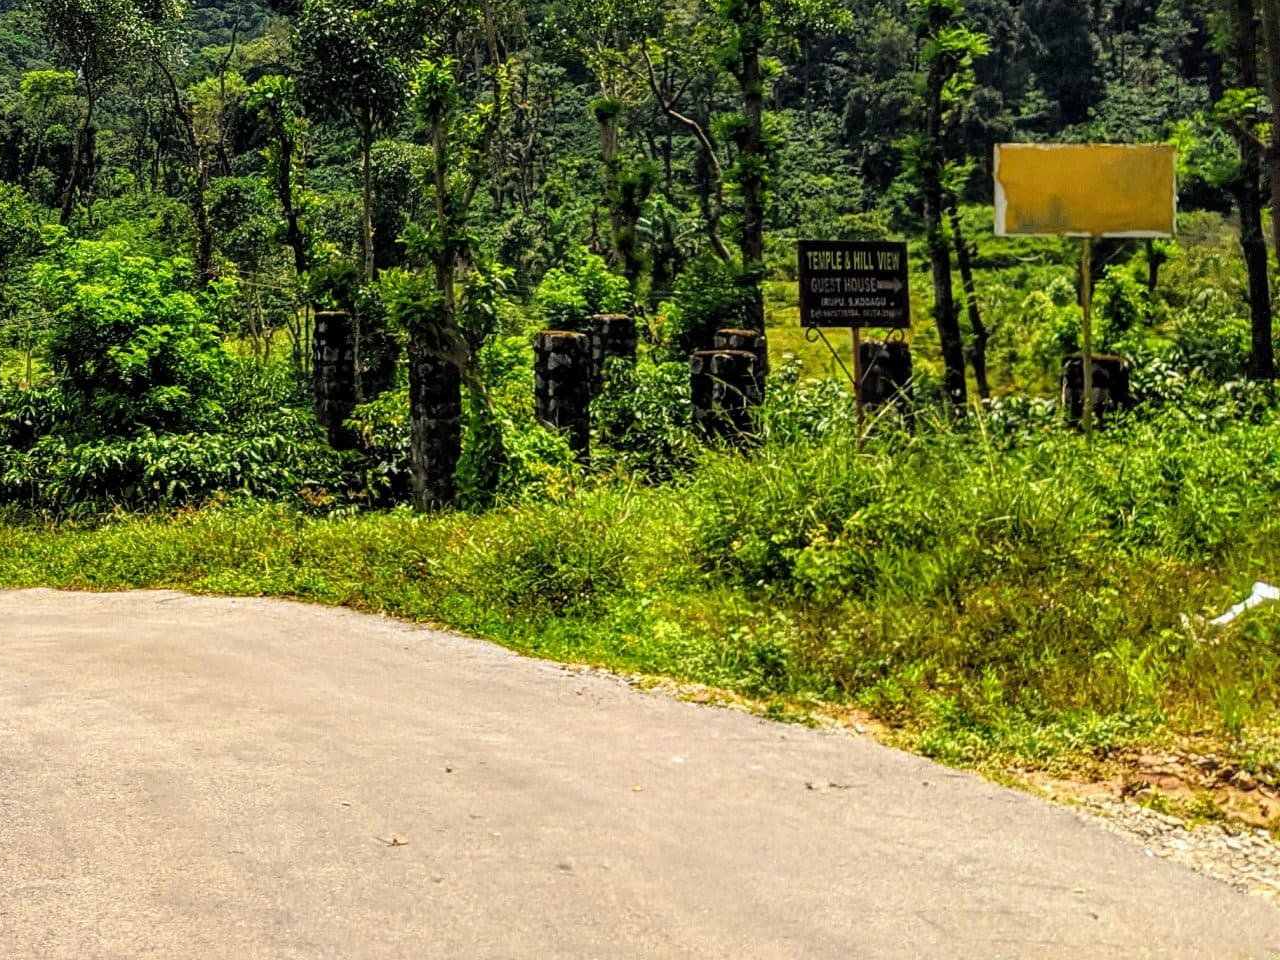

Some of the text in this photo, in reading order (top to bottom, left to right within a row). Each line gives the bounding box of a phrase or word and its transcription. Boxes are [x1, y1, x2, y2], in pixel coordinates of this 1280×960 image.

[806, 251, 900, 270] TEMPLE & HILL VIEW
[810, 278, 877, 293] GUEST HOUSE
